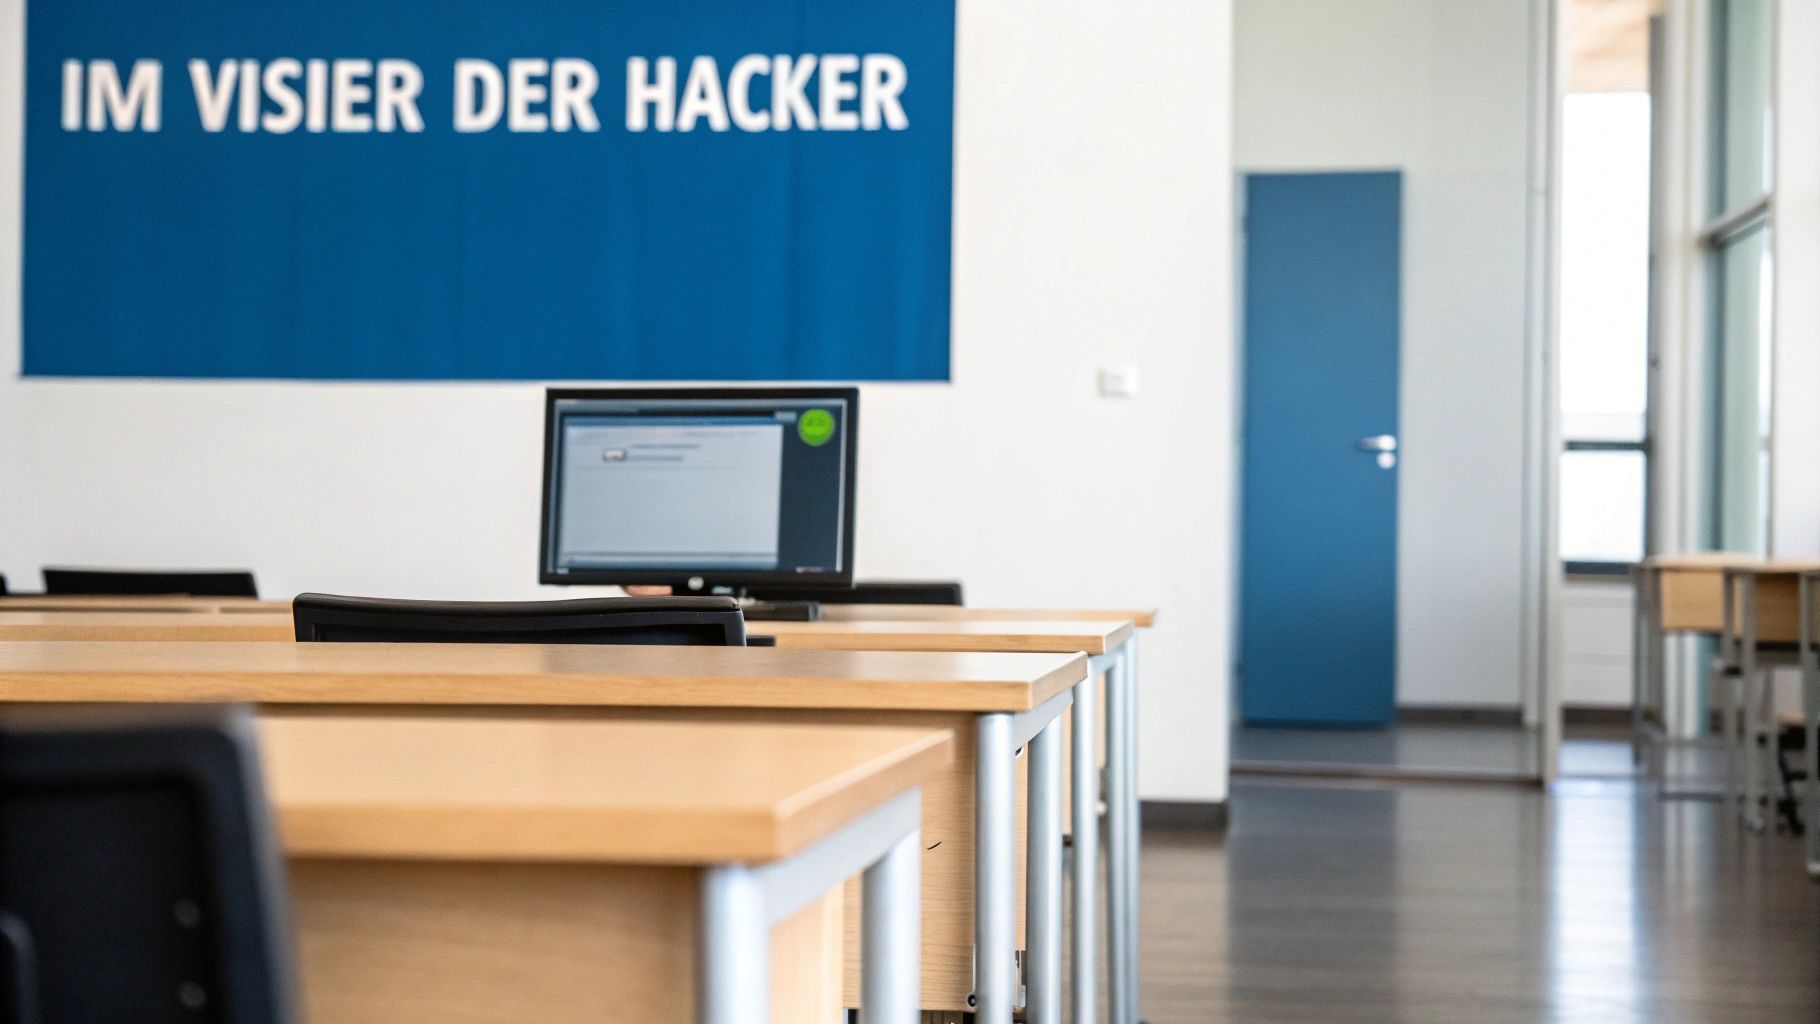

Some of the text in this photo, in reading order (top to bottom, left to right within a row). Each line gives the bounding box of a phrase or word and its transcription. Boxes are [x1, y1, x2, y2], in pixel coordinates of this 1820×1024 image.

[62, 54, 908, 134] IM VISIER DER HACKER
